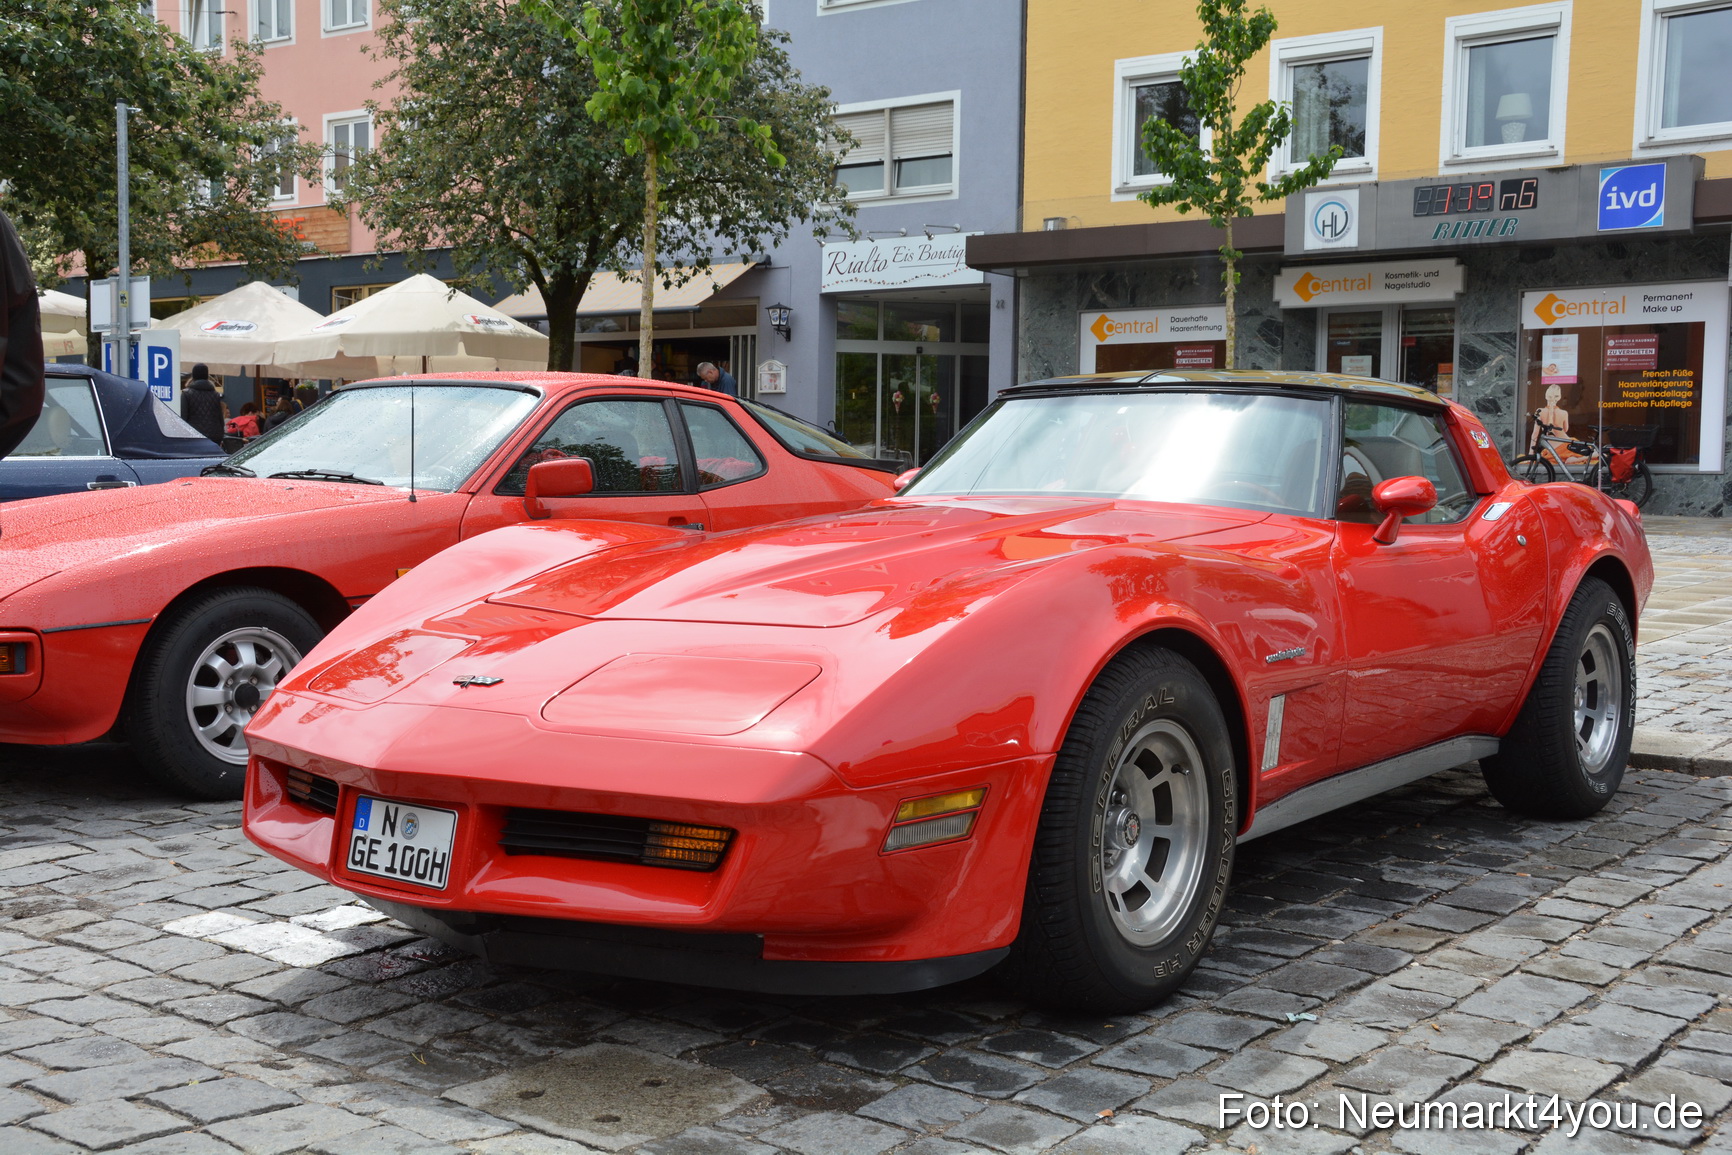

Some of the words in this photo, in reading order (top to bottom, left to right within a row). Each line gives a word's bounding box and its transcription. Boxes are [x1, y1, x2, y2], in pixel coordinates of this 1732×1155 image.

[1606, 182, 1656, 210] ivd
[1431, 217, 1519, 240] RITTER
[826, 246, 888, 276] Rialto
[892, 246, 914, 263] Eis
[917, 243, 966, 268] Boutiq
[1384, 272, 1422, 281] Kosmetik-
[1423, 270, 1440, 278] und
[1384, 281, 1431, 290] Nagelstudio
[1643, 292, 1693, 303] Permanent
[1642, 305, 1668, 313] Make
[1670, 305, 1683, 313] up
[1170, 315, 1208, 323] Dauerhafte
[1170, 323, 1222, 333] Haarentfernung
[154, 353, 168, 378] P
[1642, 370, 1670, 378] French
[1672, 369, 1694, 377] Füße
[1618, 379, 1694, 389] Haarverlängerung
[1622, 390, 1693, 399] Nagelmodellage
[1650, 399, 1693, 409] Fußpflege
[358, 818, 365, 828] D
[382, 805, 399, 837] N
[1186, 768, 1234, 956] GRABBER
[1154, 952, 1184, 979] HP
